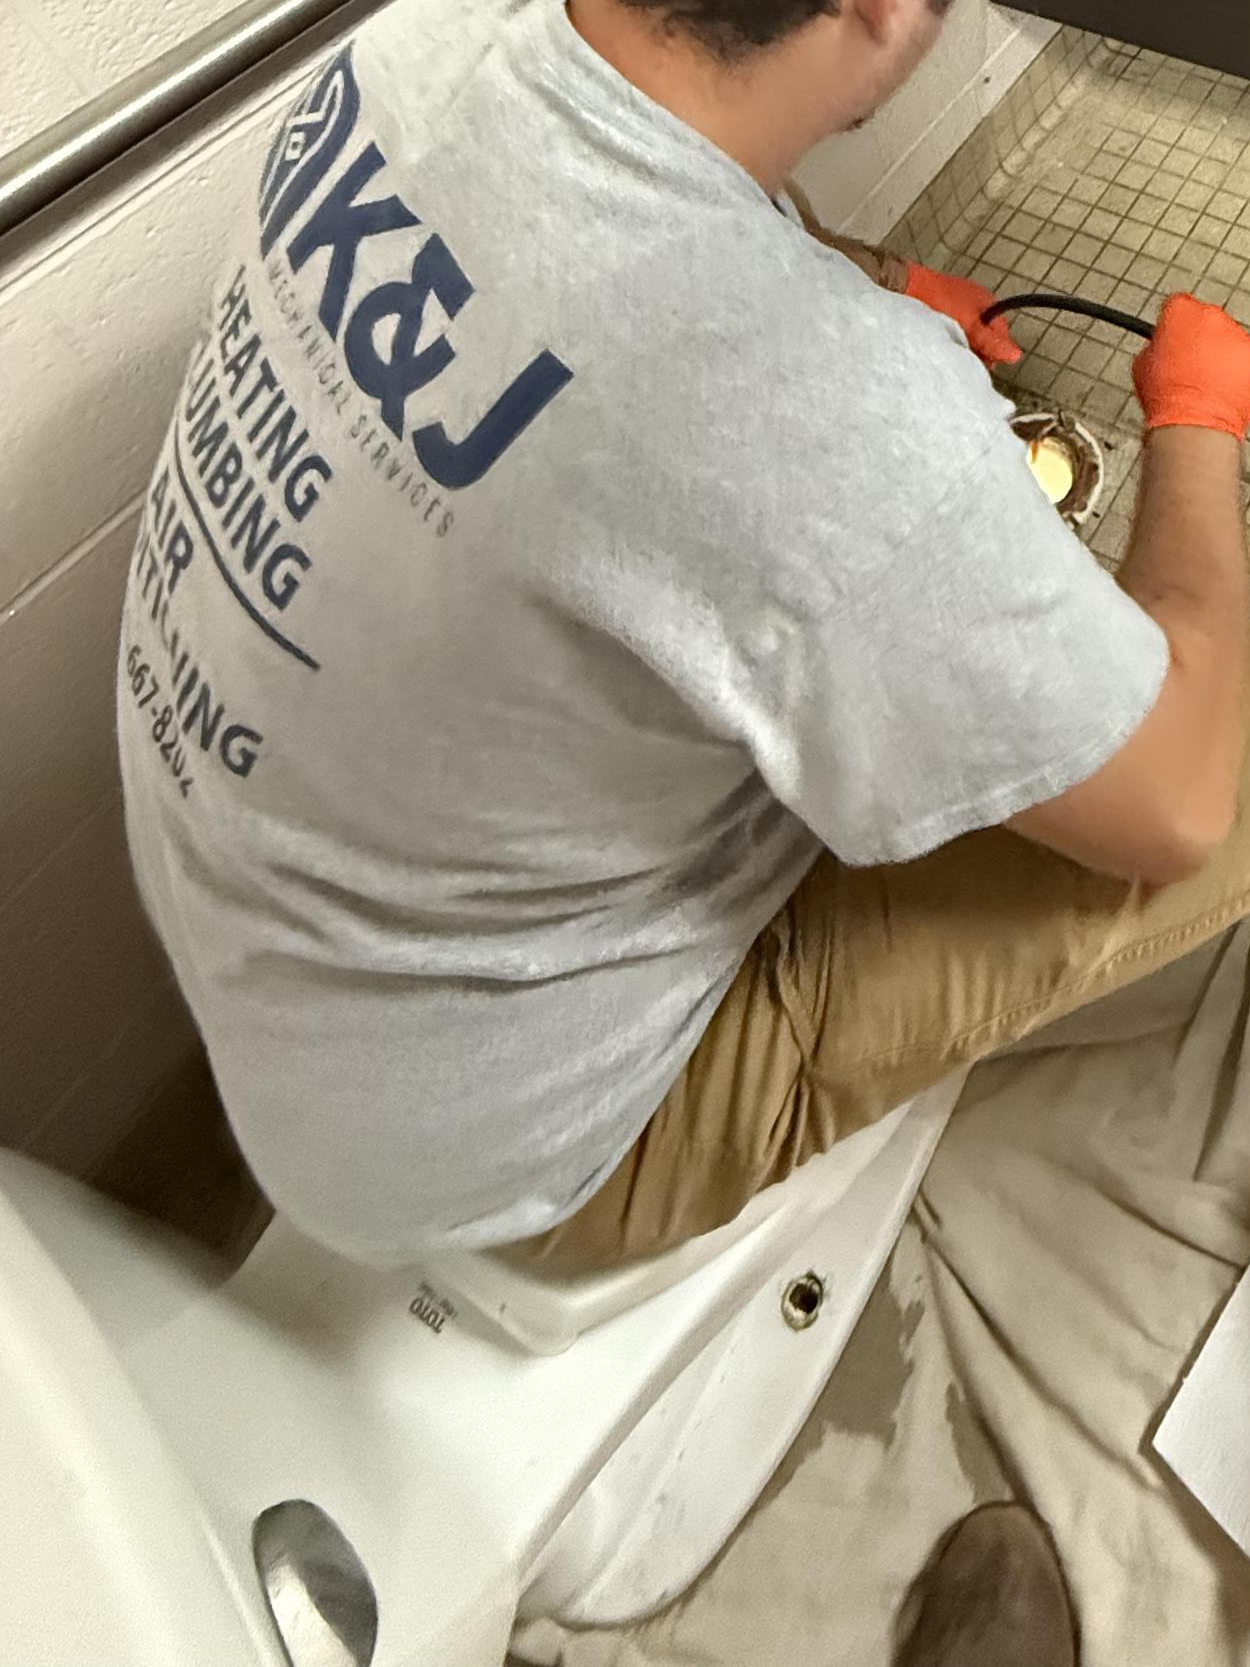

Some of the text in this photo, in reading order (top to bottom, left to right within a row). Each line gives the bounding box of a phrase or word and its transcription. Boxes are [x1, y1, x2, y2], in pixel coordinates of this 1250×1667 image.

[219, 263, 333, 523] HEATING
[287, 141, 574, 491] K&J
[151, 464, 195, 596] AIR
[408, 1296, 446, 1334] TOTO
